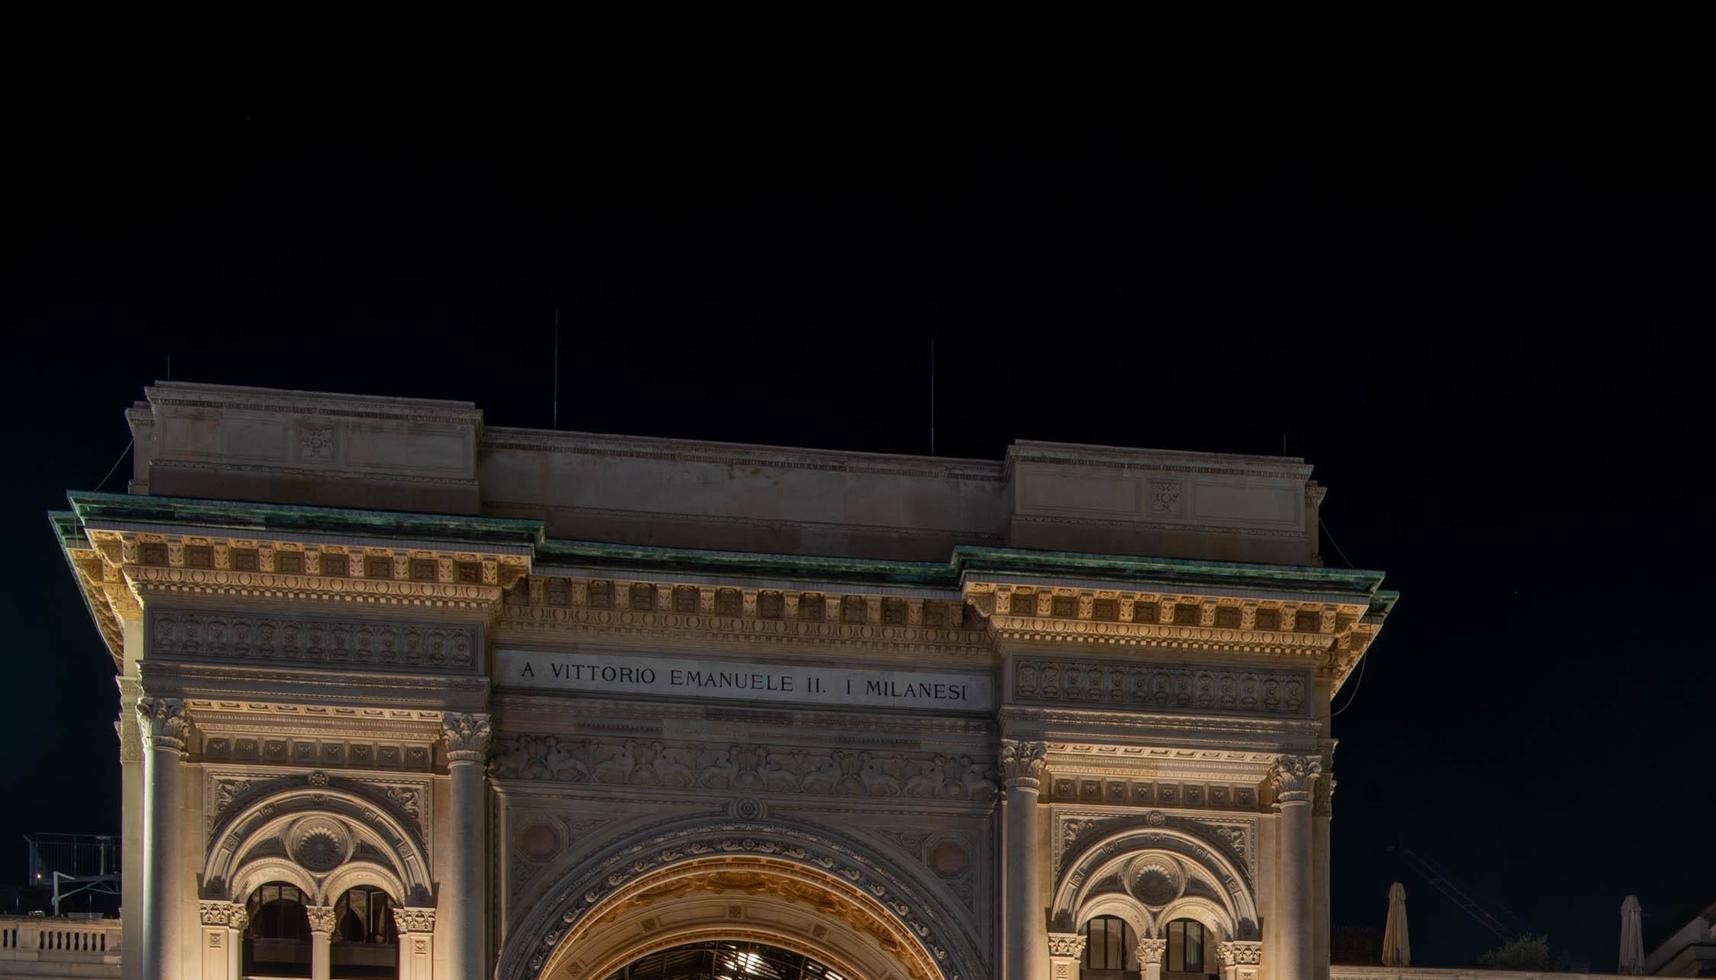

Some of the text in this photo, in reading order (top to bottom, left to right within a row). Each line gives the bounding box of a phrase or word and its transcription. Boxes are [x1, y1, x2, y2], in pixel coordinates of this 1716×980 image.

[521, 661, 535, 678] A
[550, 663, 656, 685] VITTORIO
[670, 669, 794, 693] EMANUELE
[865, 680, 967, 701] MILANESI
